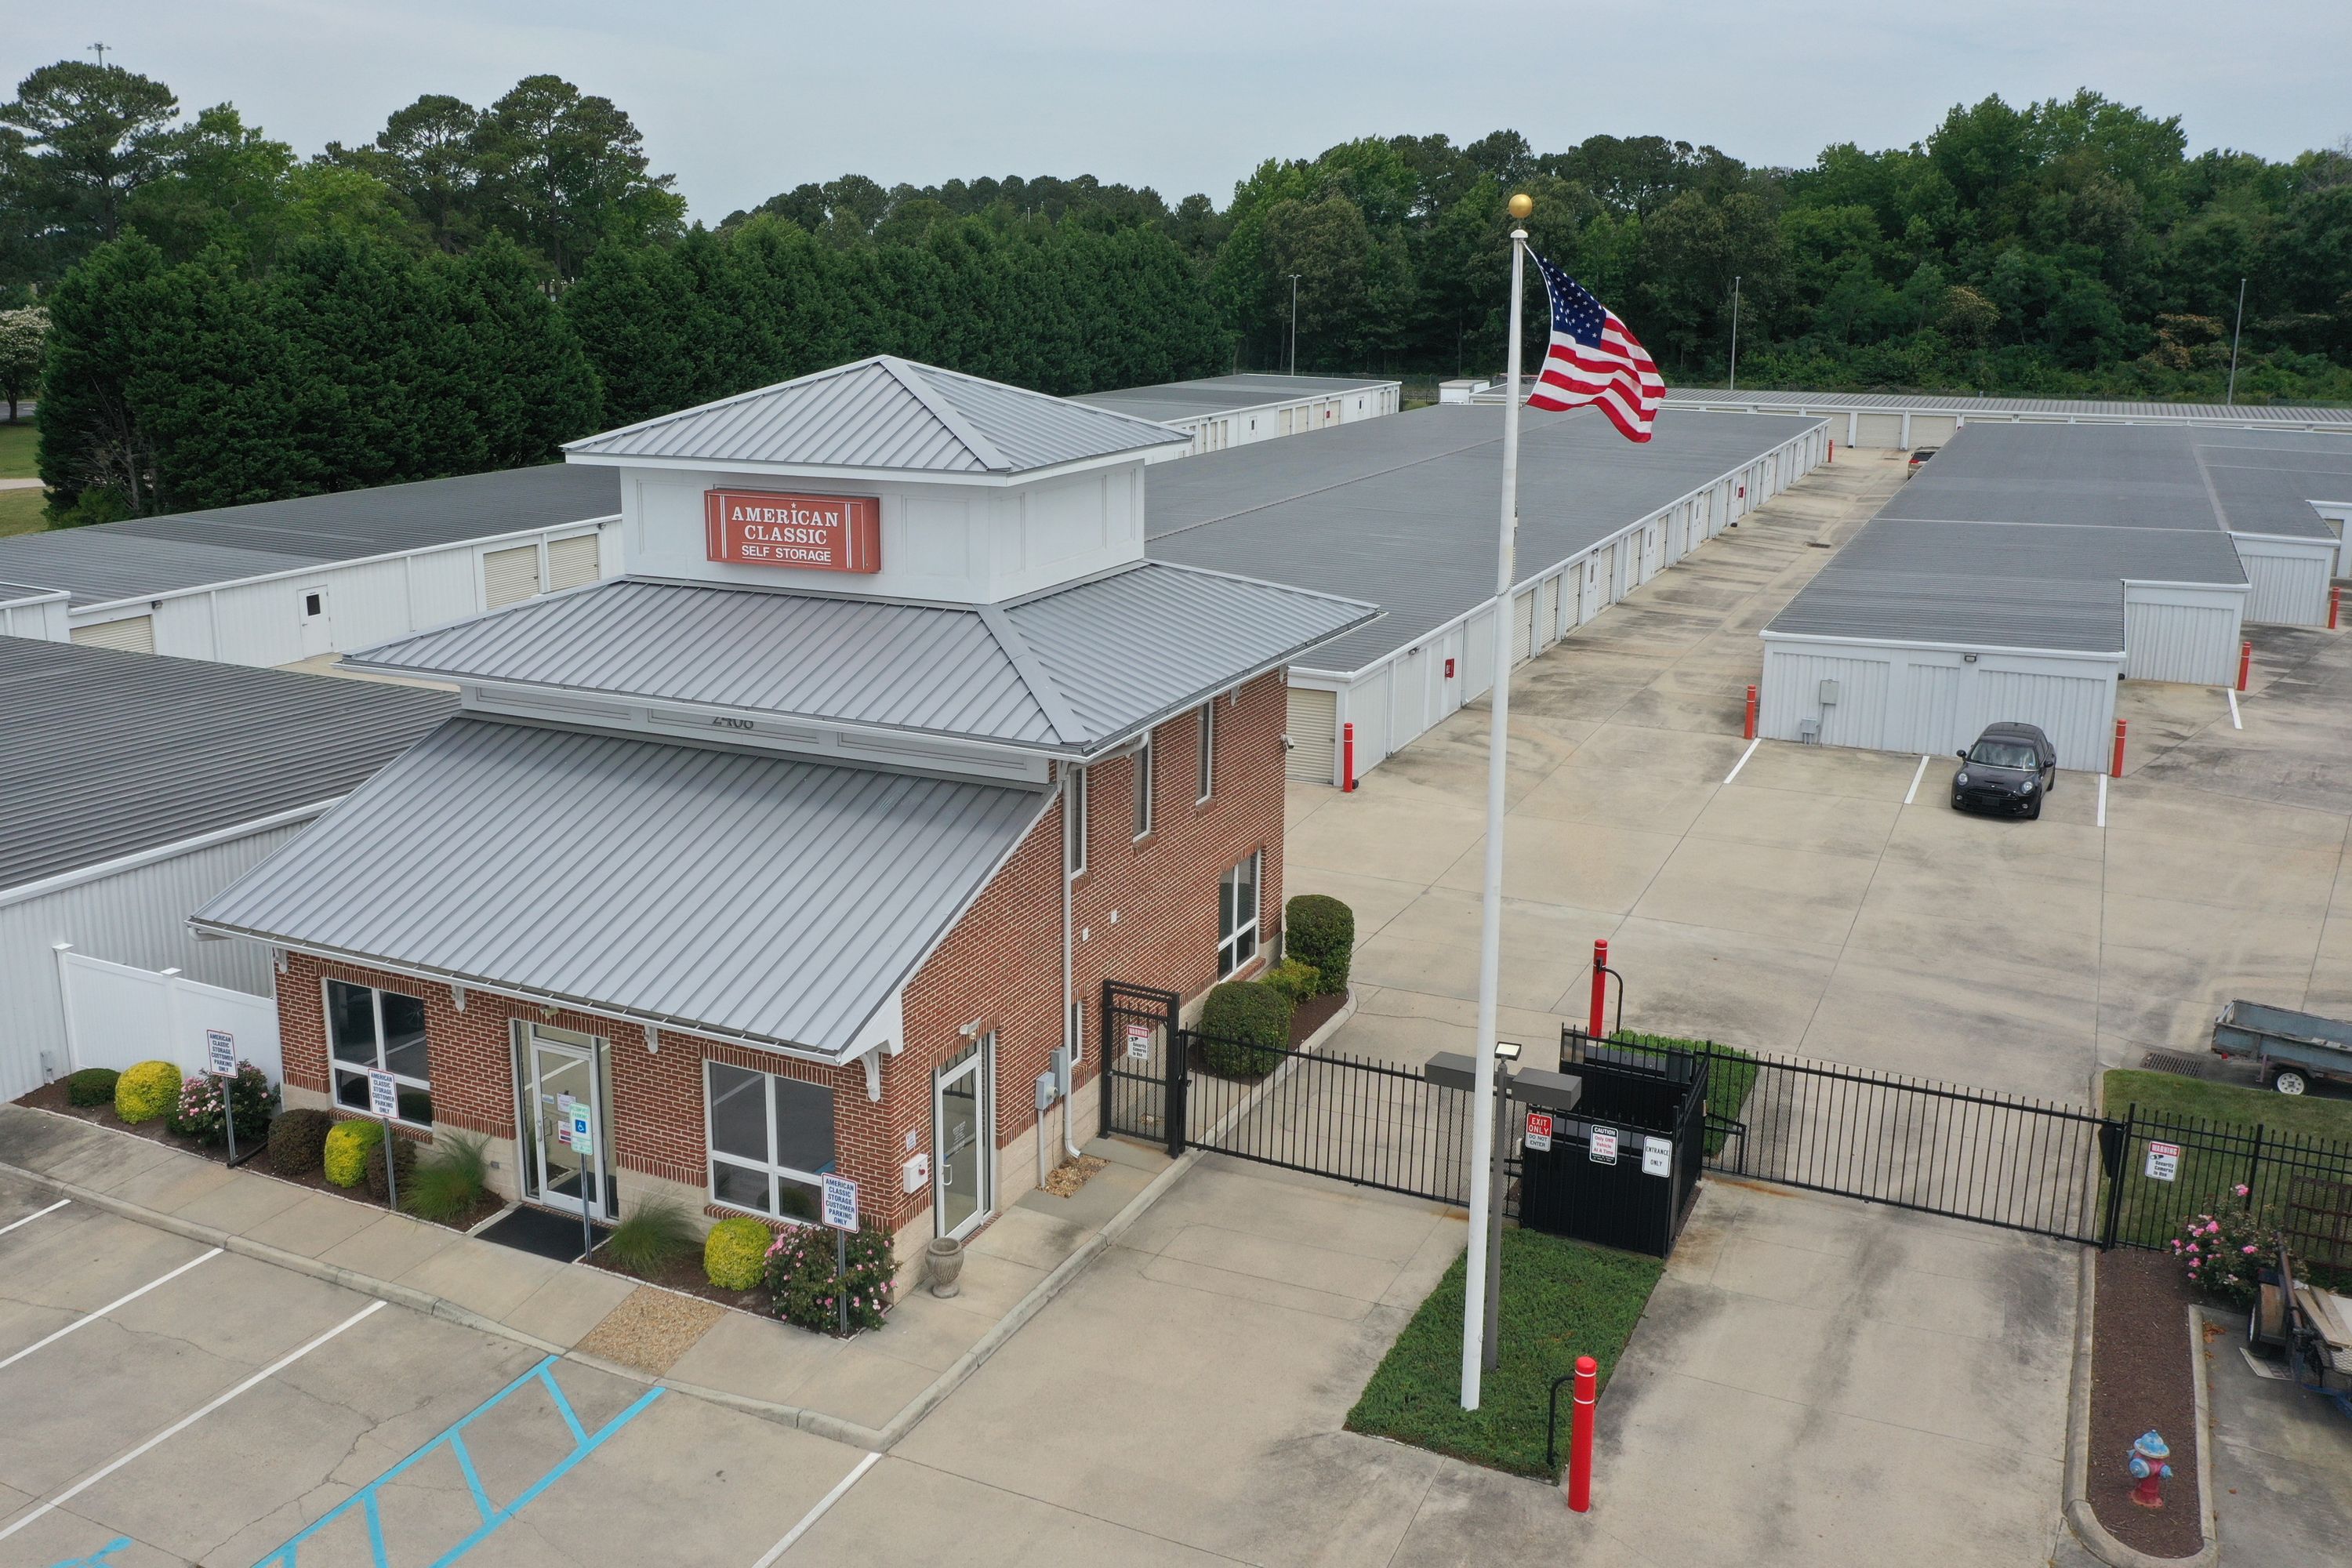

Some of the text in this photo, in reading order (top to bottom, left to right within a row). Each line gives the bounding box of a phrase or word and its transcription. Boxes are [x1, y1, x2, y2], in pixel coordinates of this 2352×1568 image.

[731, 506, 839, 528] AMERICAN
[744, 524, 827, 545] CLASSIC
[741, 545, 831, 562] SELF STORAGE
[209, 1033, 231, 1043] AMERICAN
[212, 1040, 230, 1048] CLASSIC
[212, 1046, 231, 1054] STORAGE
[212, 1052, 234, 1062] CUSTOMER
[214, 1058, 232, 1067] PARKING
[371, 1072, 393, 1082] AMERICAN
[373, 1080, 391, 1089] CLASSIC
[373, 1086, 393, 1095] STORAGE
[372, 1091, 395, 1102] CUSTOMER
[375, 1099, 394, 1109] PARKING
[1531, 1117, 1548, 1127] EXIT
[1529, 1124, 1549, 1135] ONLY
[1594, 1127, 1616, 1136] CAUTION
[1646, 1145, 1669, 1156] ENTRANCE
[2151, 1144, 2178, 1156] WARNING
[2154, 1165, 2174, 1174] Cameras
[2155, 1160, 2175, 1169] Security
[826, 1178, 855, 1192] AMERICAN
[829, 1186, 851, 1198] CLASSIC
[828, 1193, 852, 1206] STORAGE
[826, 1200, 855, 1214] CUSTOMER
[829, 1208, 852, 1220] PARKING
[833, 1217, 848, 1225] ONLY
